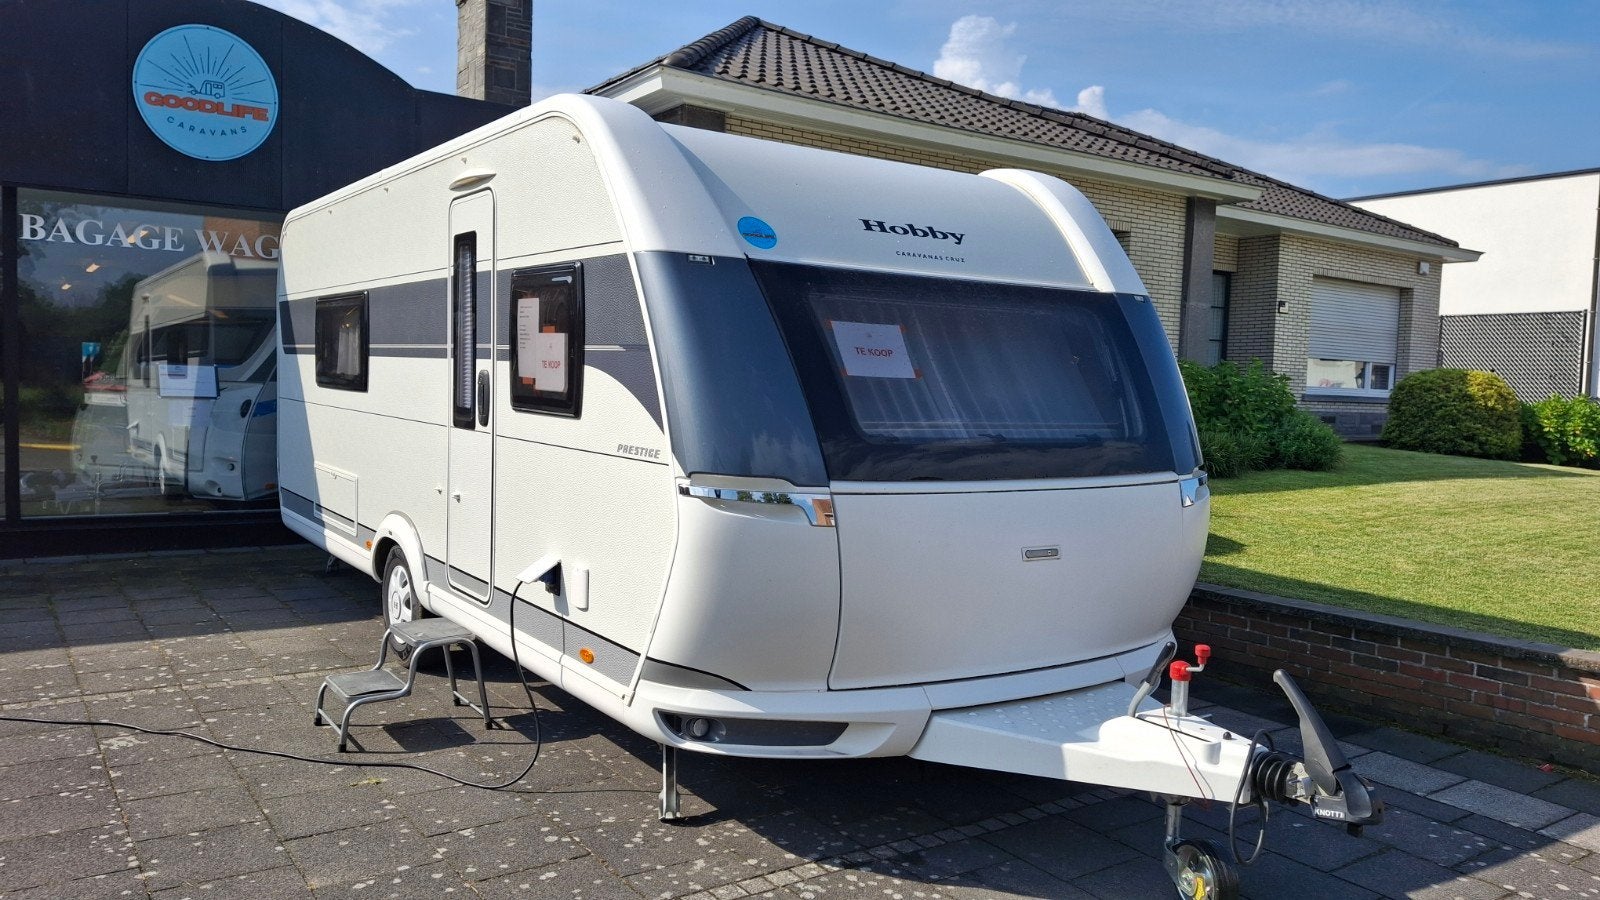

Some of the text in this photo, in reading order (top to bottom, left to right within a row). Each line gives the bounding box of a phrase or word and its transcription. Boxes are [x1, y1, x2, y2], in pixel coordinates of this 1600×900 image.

[144, 91, 269, 122] GOODLIFE
[166, 115, 248, 137] CARAVANS
[18, 213, 185, 252] BAGAGE
[858, 218, 965, 245] Hobby
[896, 250, 943, 261] CARAVANAS
[855, 346, 894, 358] TE KOOP
[616, 443, 661, 459] PRESTIGE
